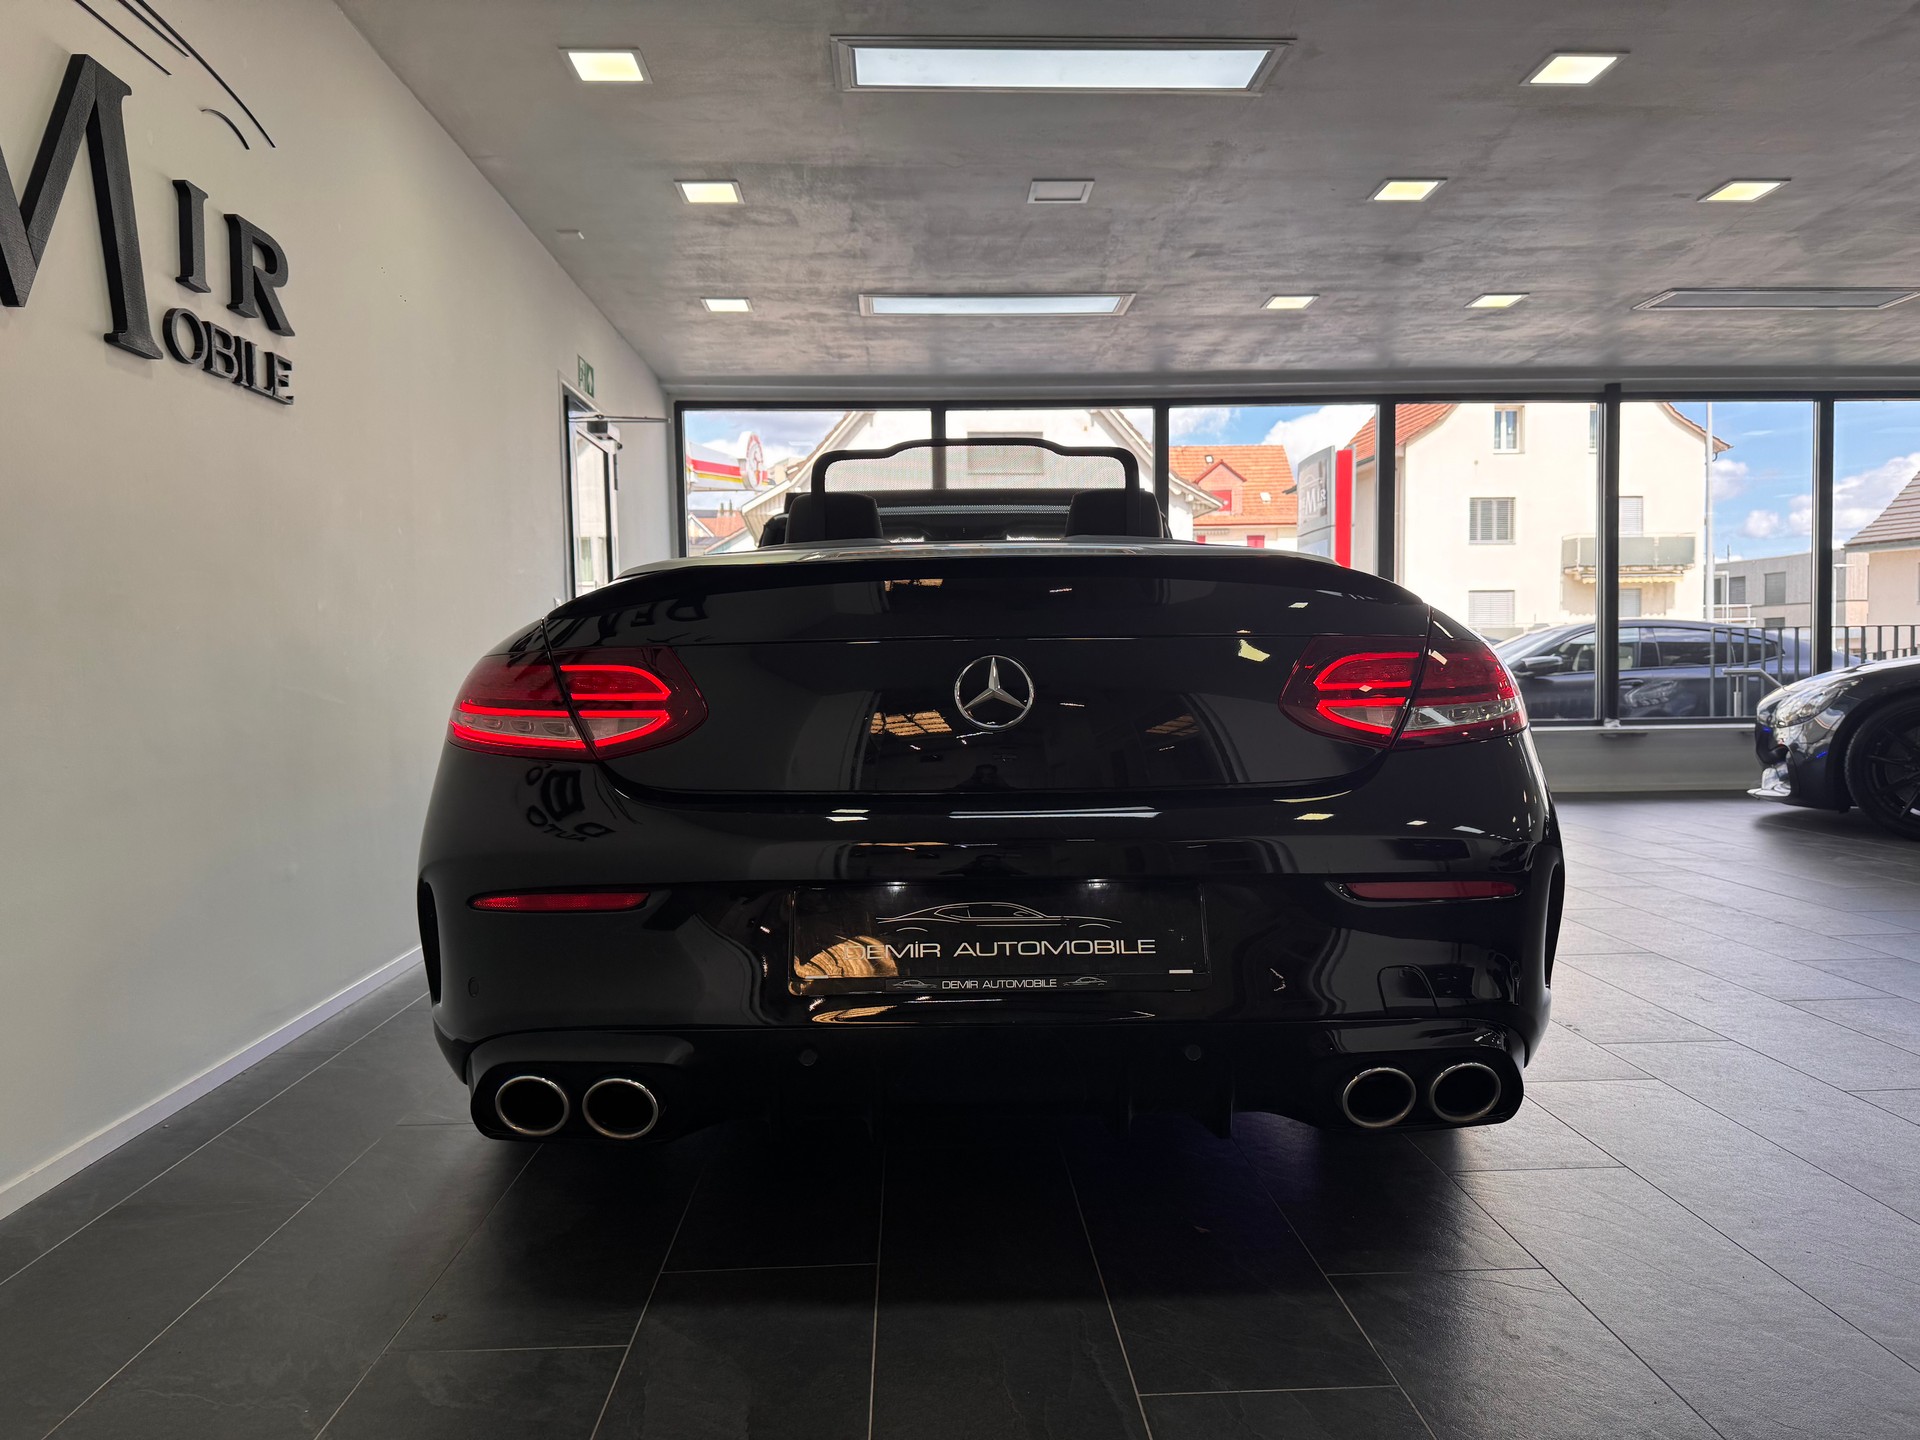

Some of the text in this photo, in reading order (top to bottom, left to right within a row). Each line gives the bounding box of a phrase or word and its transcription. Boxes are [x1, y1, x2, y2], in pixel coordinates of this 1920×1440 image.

[162, 307, 295, 405] OBILE
[953, 939, 1156, 958] AUTOMOBILE
[982, 978, 1057, 989] AUTOMOBILE
